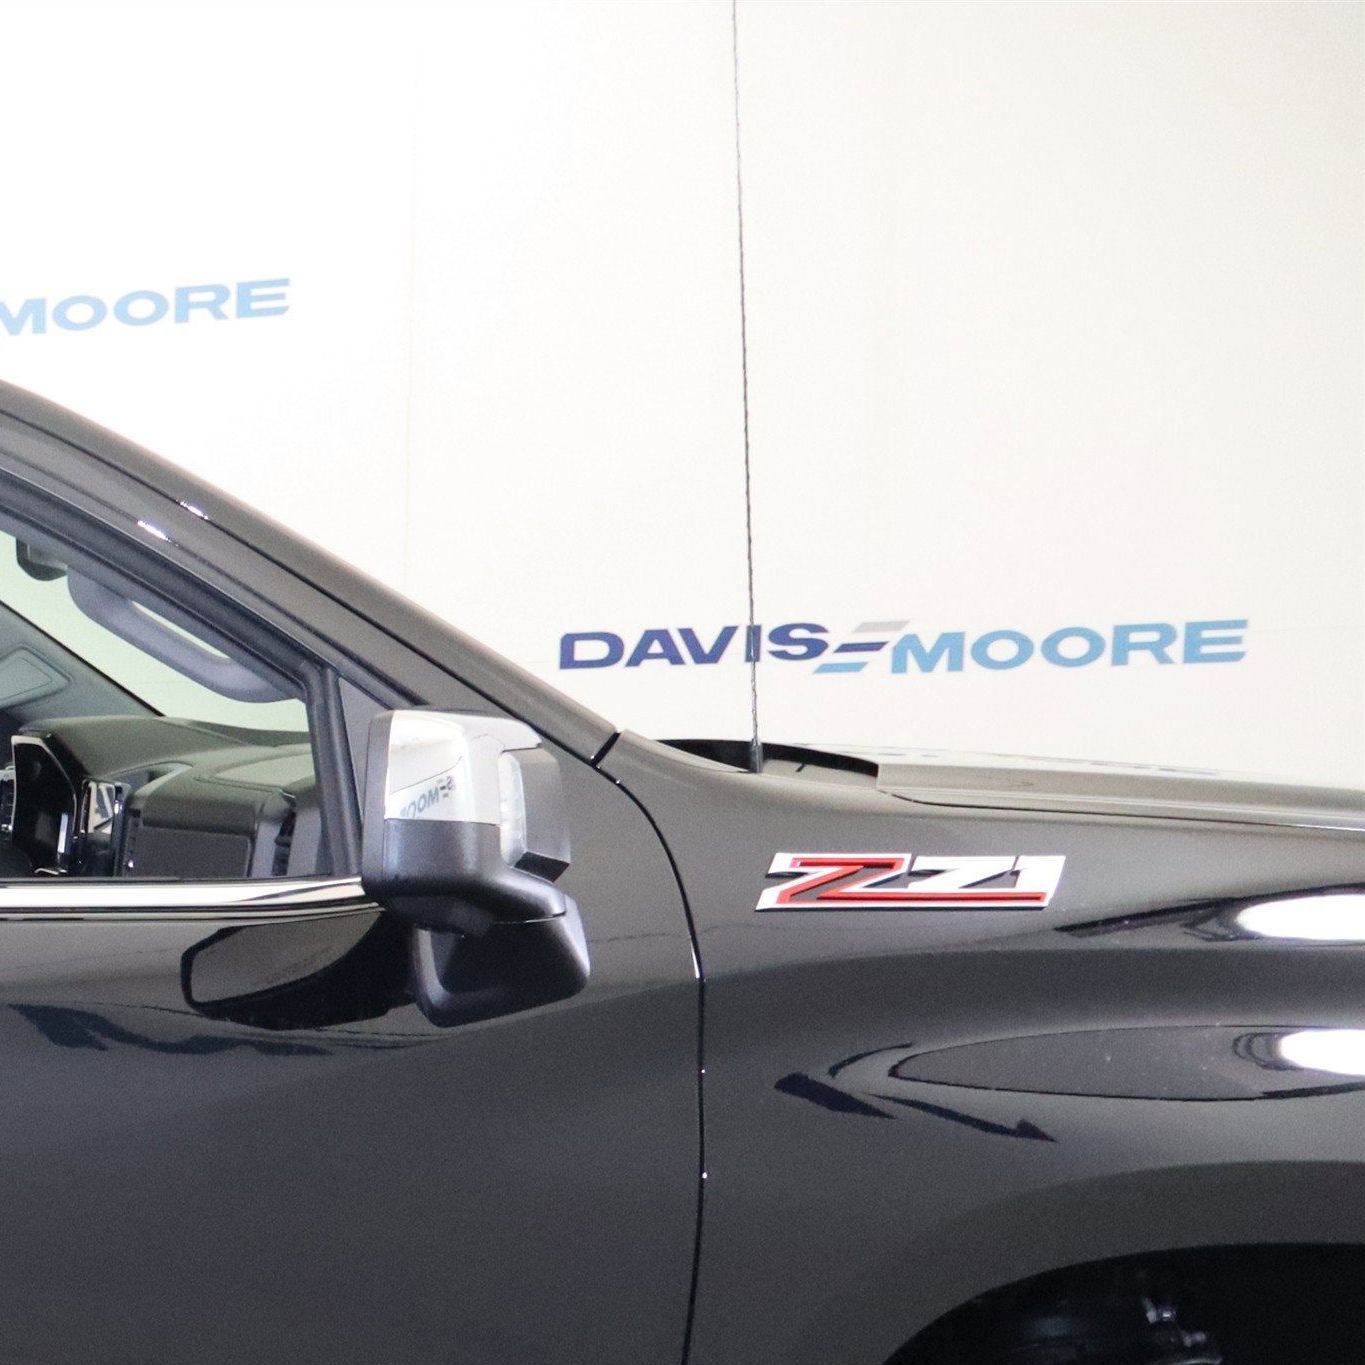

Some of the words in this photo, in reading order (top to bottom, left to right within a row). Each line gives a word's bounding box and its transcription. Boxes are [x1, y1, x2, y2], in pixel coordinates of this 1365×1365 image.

[559, 621, 829, 670] DAVIS
[890, 619, 1249, 674] MOORE
[755, 852, 1066, 911] Z71
